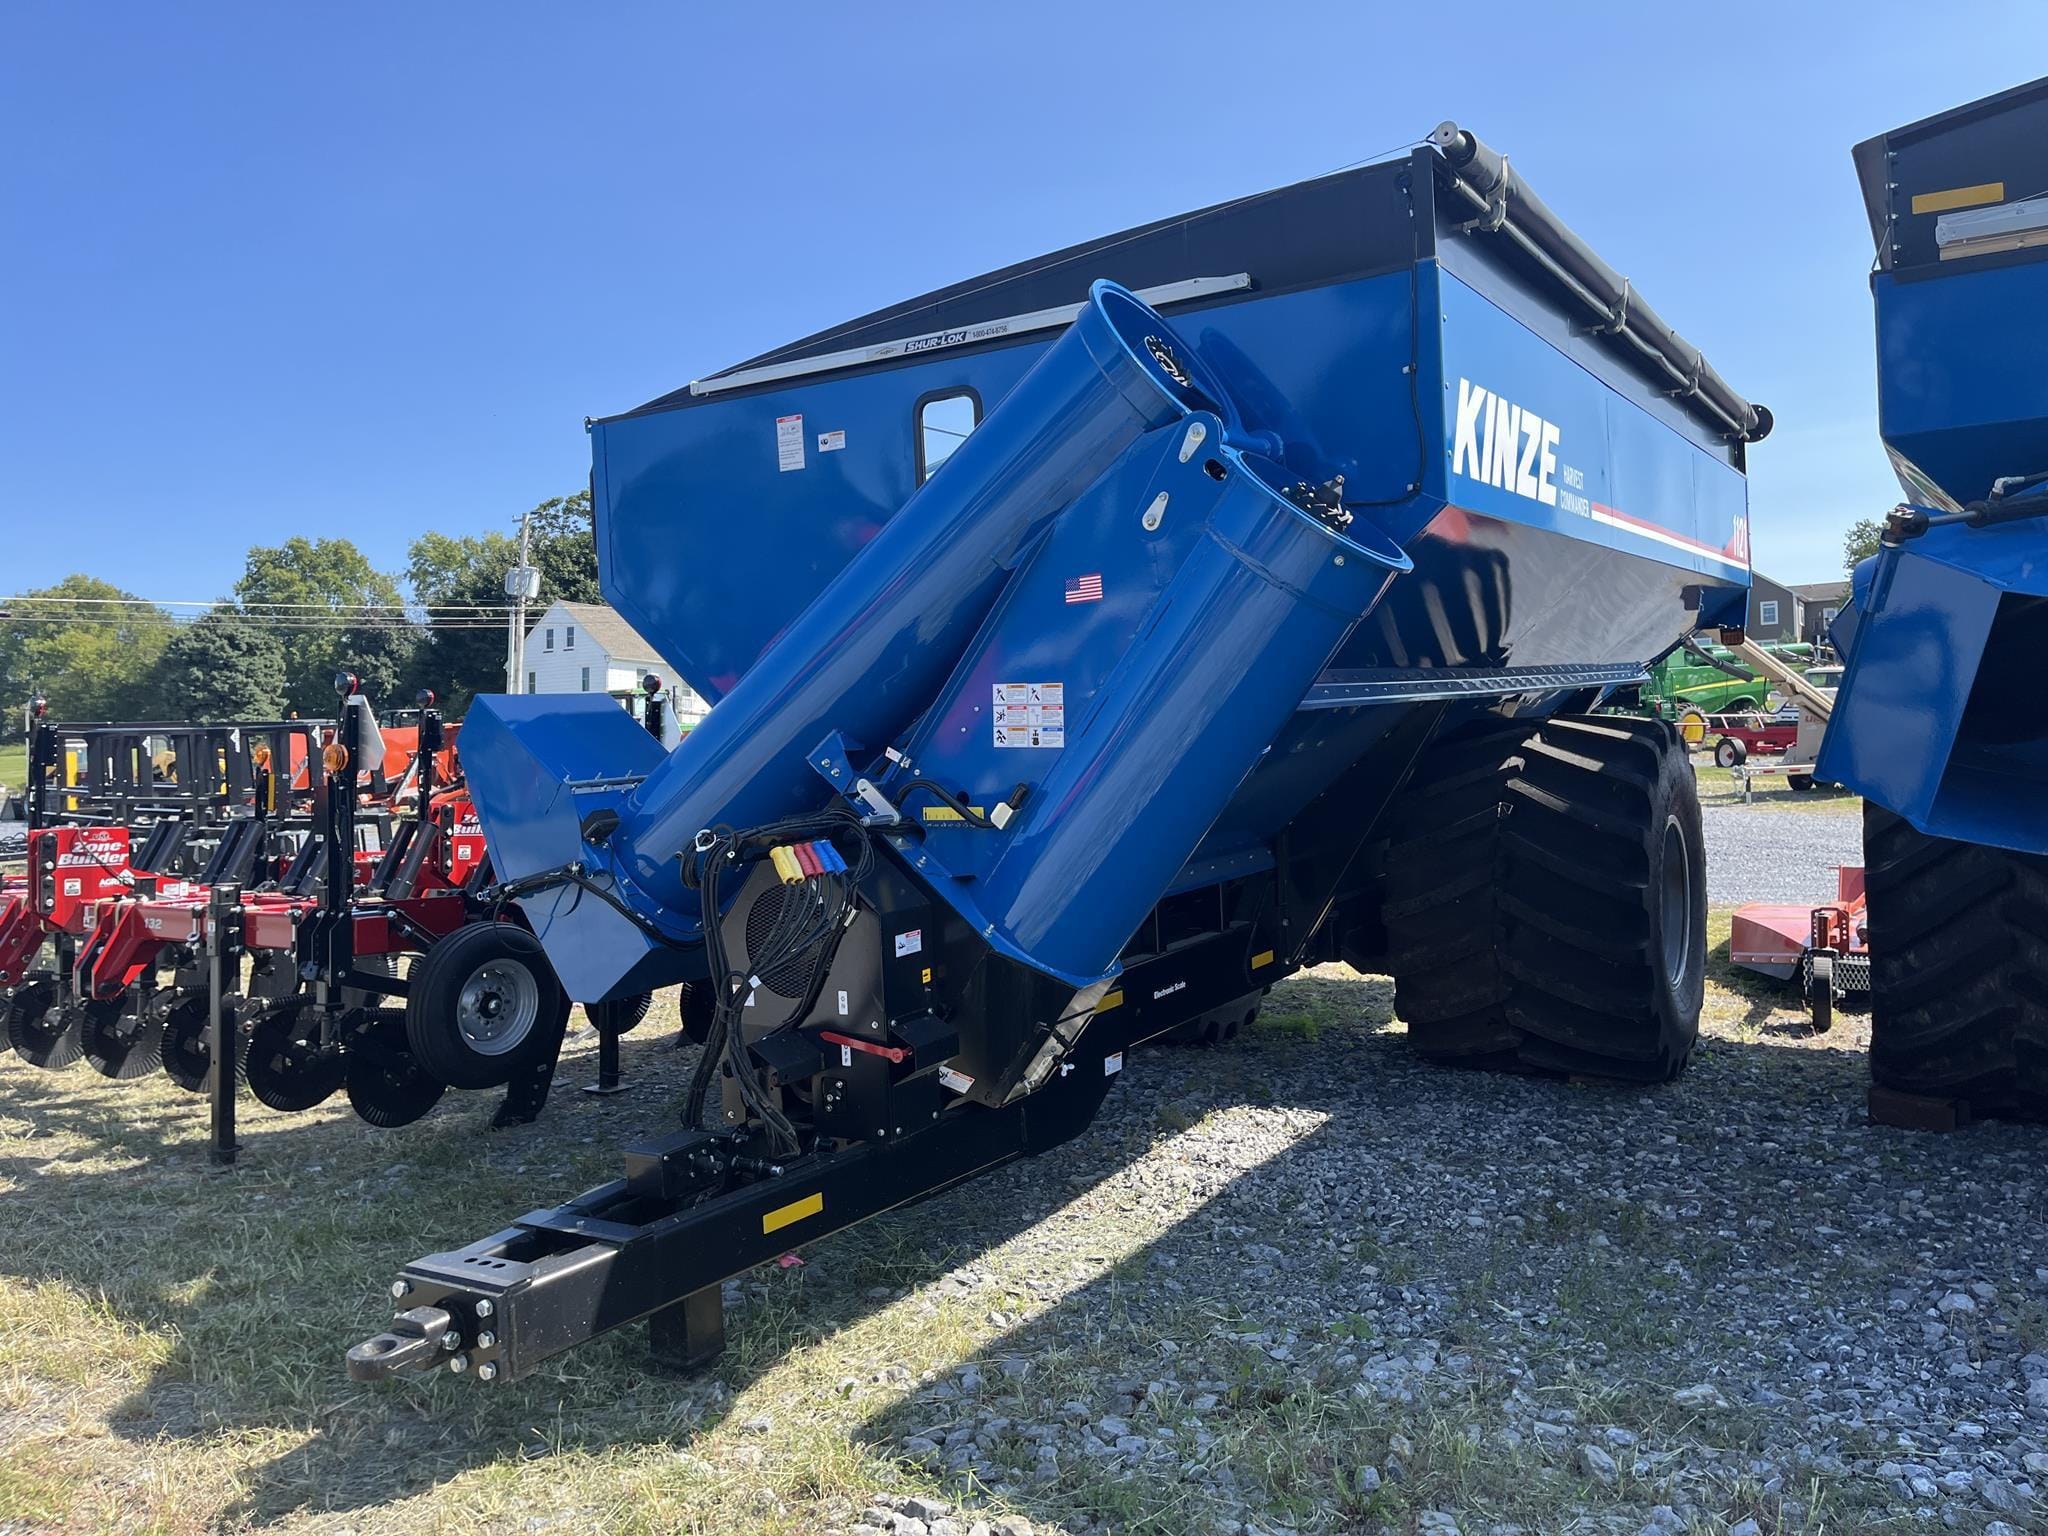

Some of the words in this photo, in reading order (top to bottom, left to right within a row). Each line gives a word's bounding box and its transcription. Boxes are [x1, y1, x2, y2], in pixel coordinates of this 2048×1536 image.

[1453, 377, 1560, 507] KINZE
[1563, 463, 1584, 491] HARVEST
[1560, 489, 1590, 519] COMMANDER
